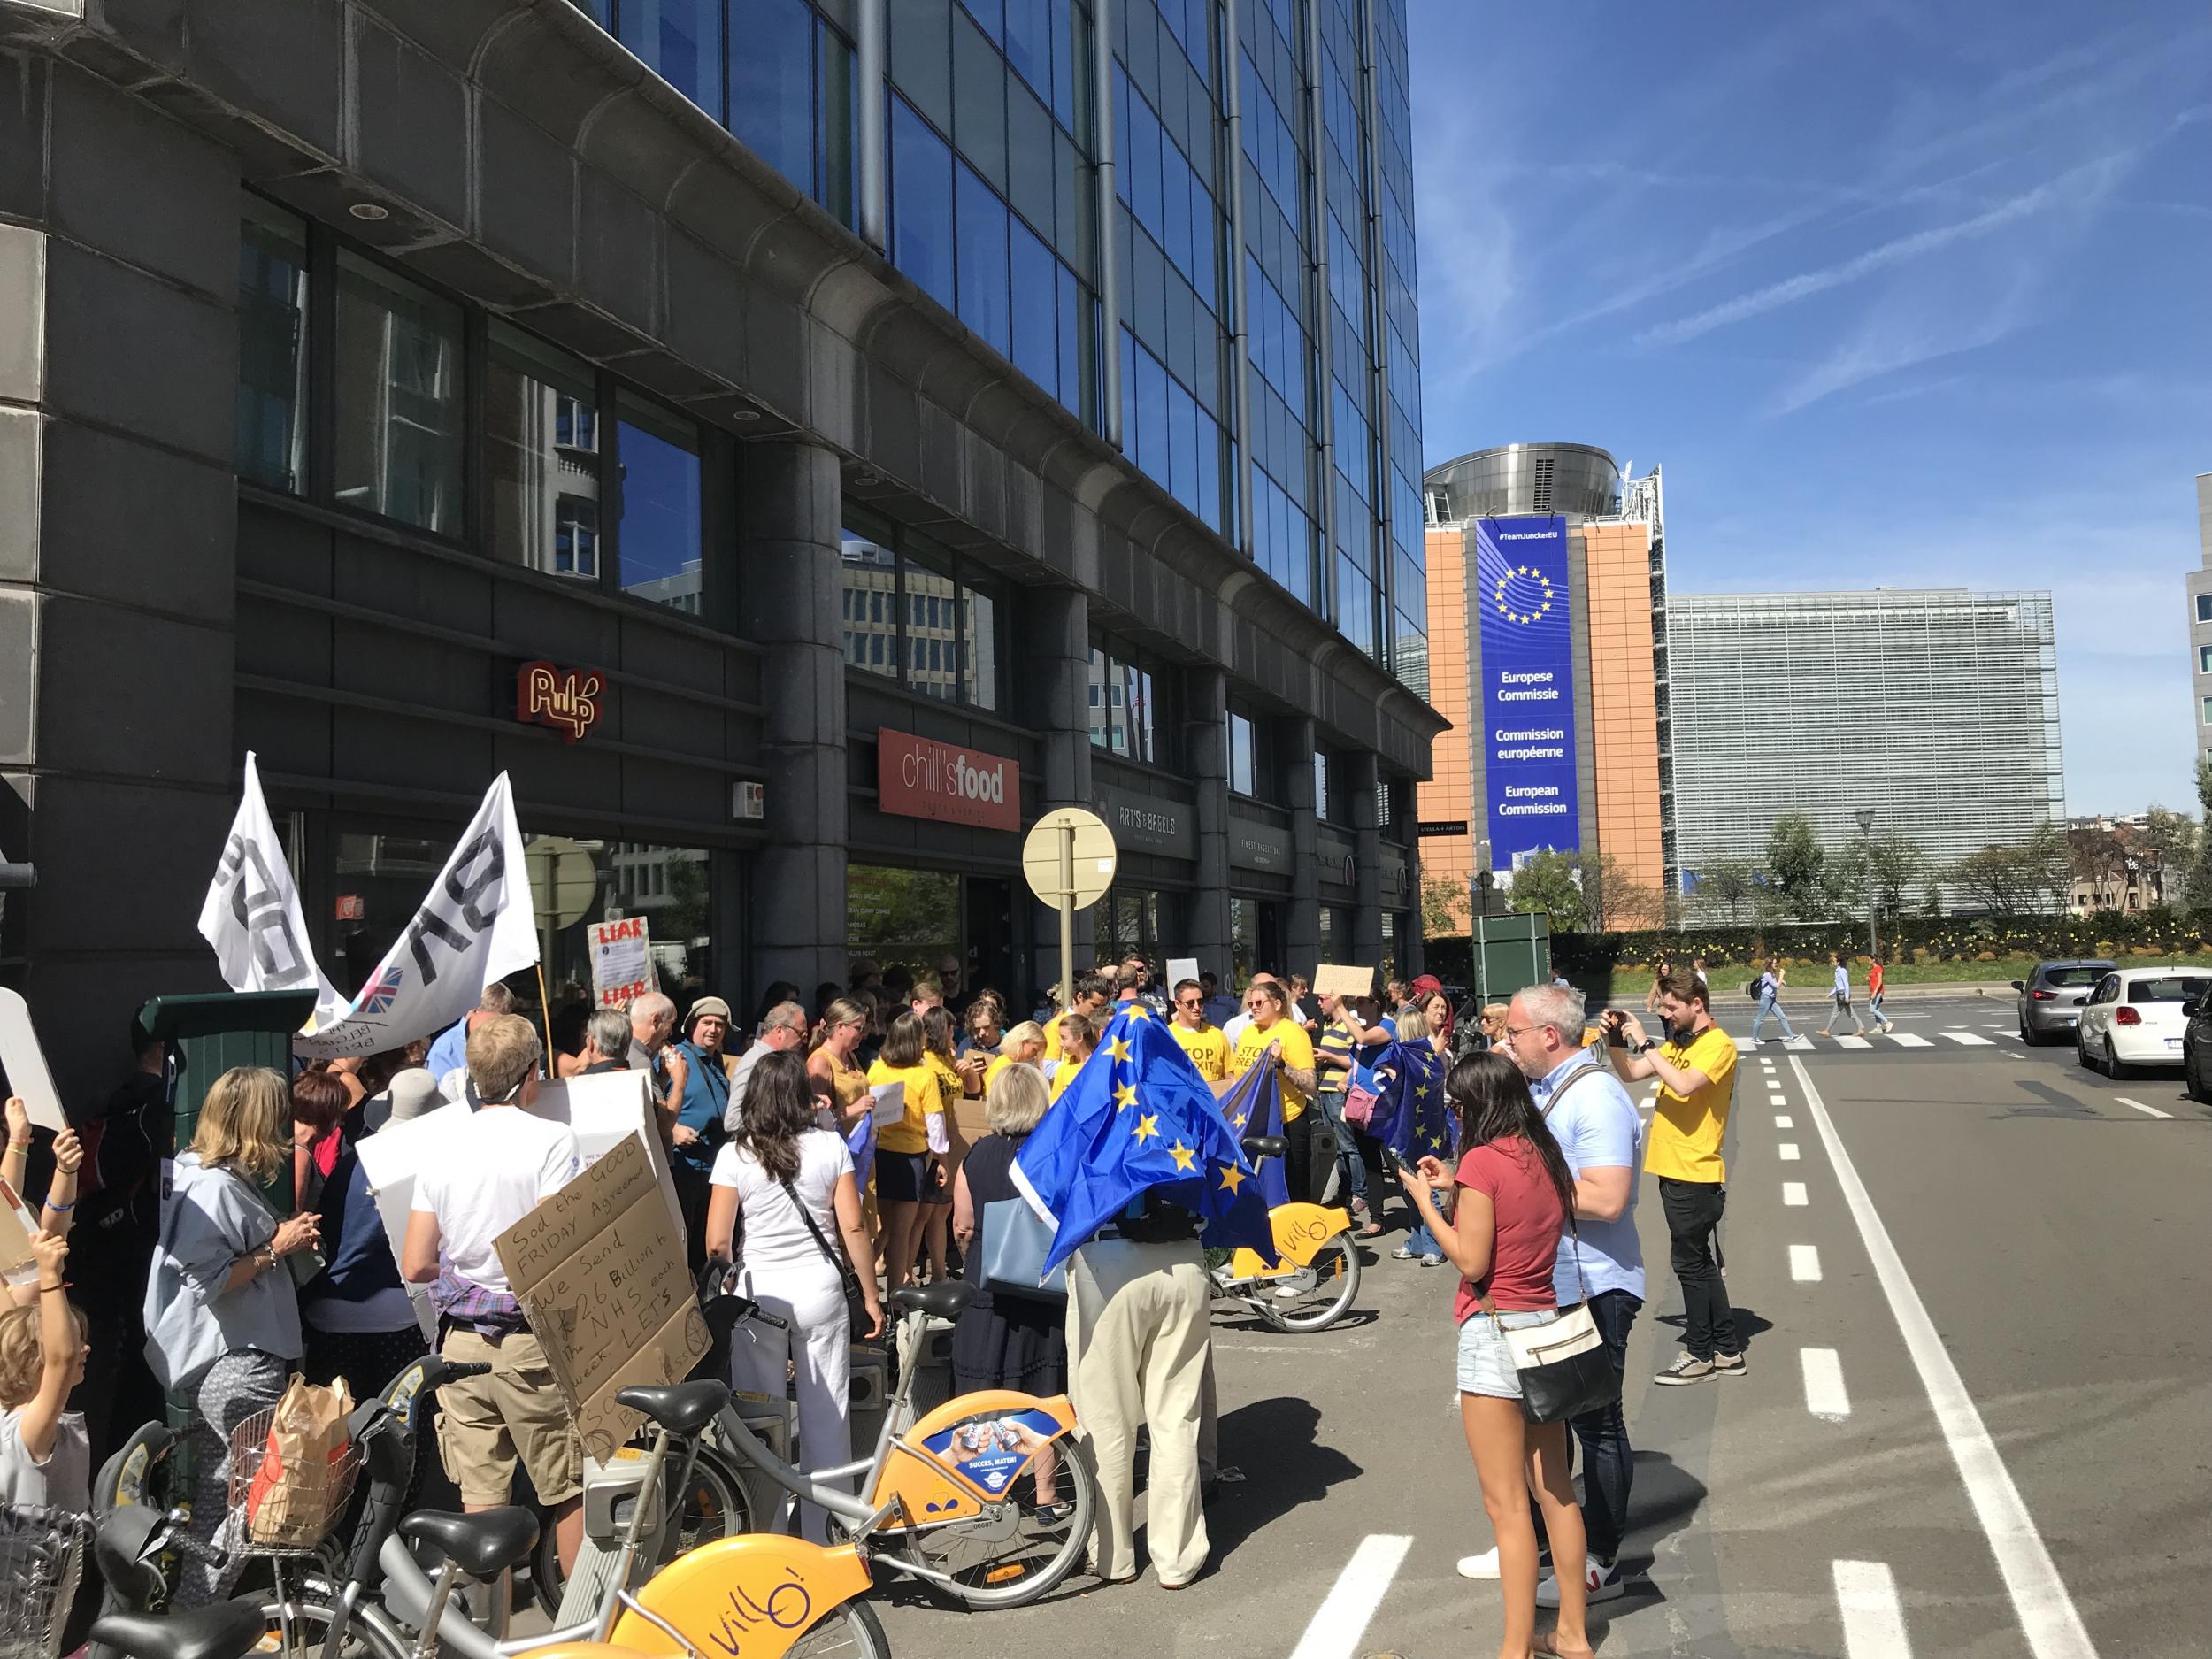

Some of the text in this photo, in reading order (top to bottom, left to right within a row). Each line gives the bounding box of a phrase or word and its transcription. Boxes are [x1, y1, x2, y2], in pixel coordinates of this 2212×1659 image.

[1499, 532, 1557, 541] #TeamJunckerEU
[1502, 672, 1553, 685] Europese
[530, 668, 595, 738] Pulp
[1497, 688, 1559, 702] Commissie
[1495, 728, 1563, 741] Commission
[1497, 746, 1563, 761] européenne
[1505, 786, 1559, 799] European
[1499, 803, 1567, 816] Commission
[1119, 806, 1141, 828] ART'S
[1148, 812, 1175, 835] BAGELS
[599, 918, 642, 944] LIAR
[603, 980, 646, 1004] LIAR
[1185, 1048, 1214, 1060] TOP
[1239, 1046, 1263, 1058] STO
[513, 1214, 550, 1253] Sod
[556, 1192, 582, 1212] the
[590, 1141, 636, 1183] GOOD
[518, 1164, 645, 1278] FRIDAY Agreement
[533, 1229, 625, 1310] We Send
[609, 1245, 654, 1288] Billion
[563, 1259, 675, 1363] The NHS each
[621, 1288, 672, 1348] LET'S
[969, 1460, 994, 1469] SUCCES,
[995, 1456, 1017, 1465] MATEN!
